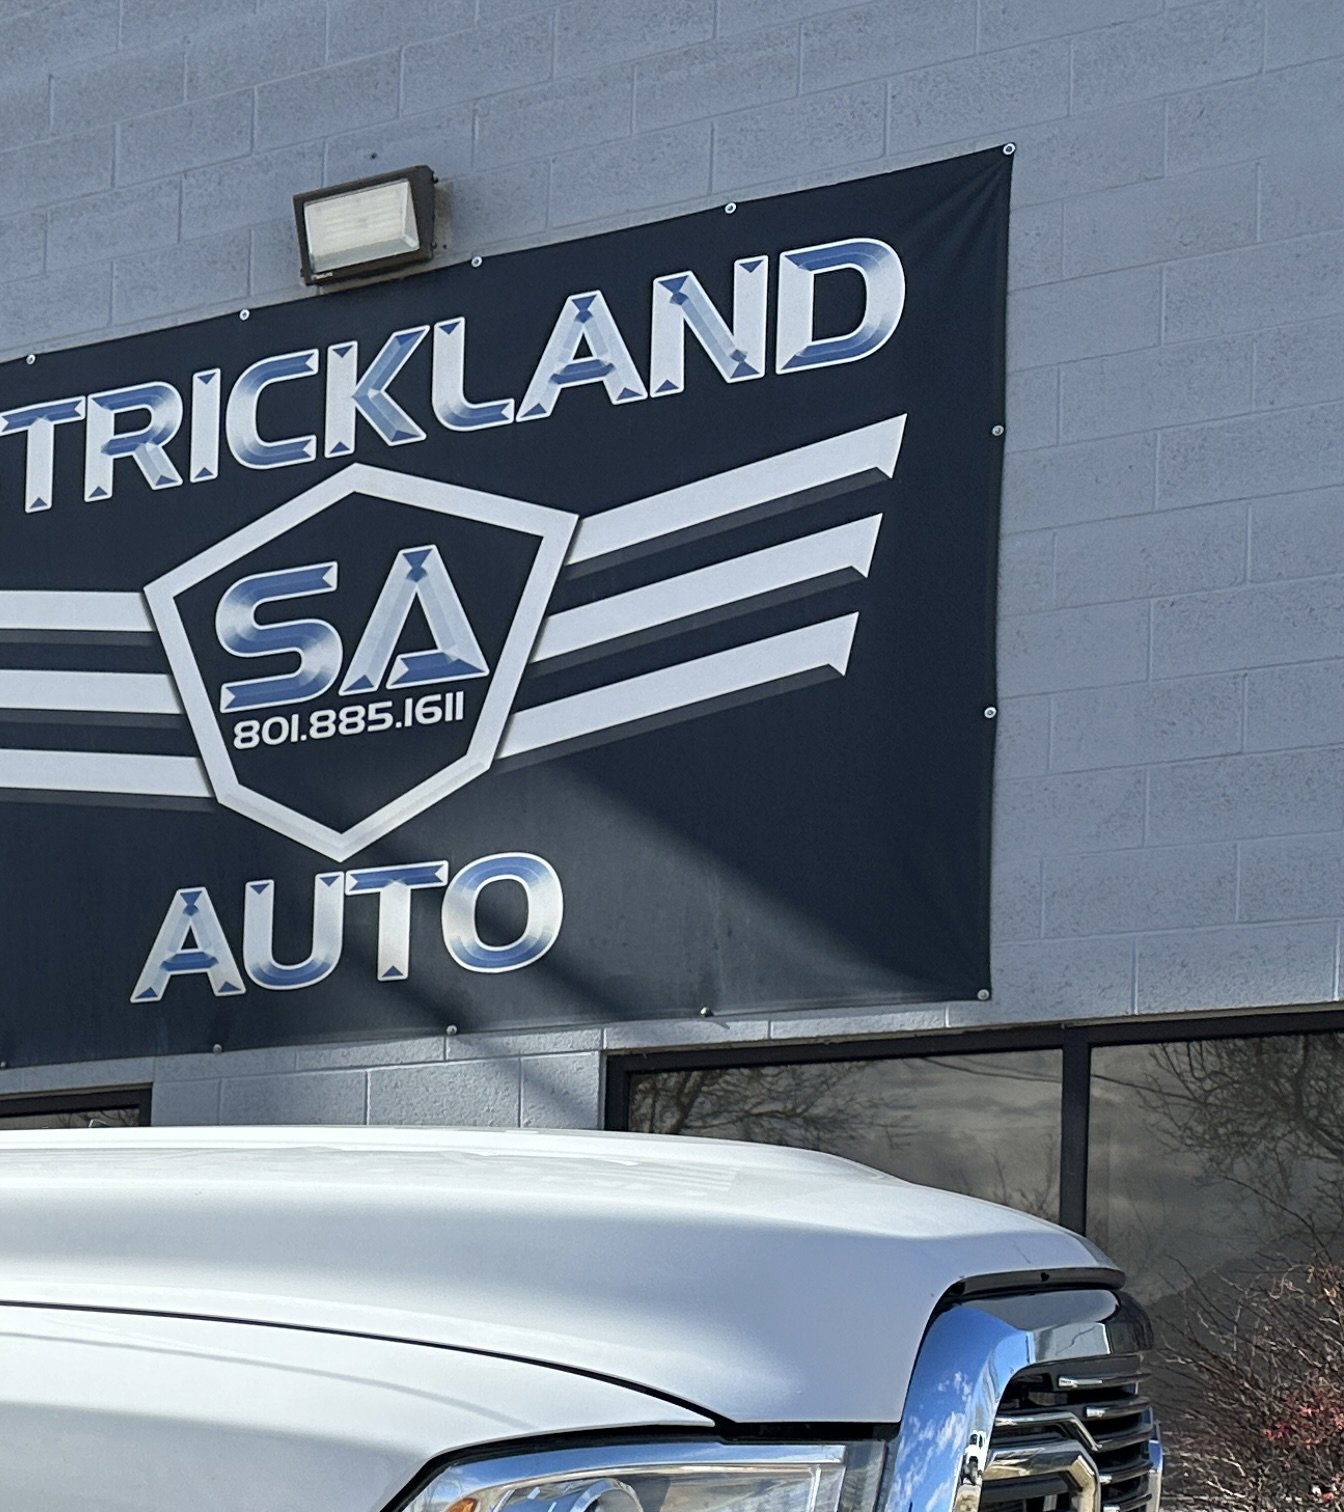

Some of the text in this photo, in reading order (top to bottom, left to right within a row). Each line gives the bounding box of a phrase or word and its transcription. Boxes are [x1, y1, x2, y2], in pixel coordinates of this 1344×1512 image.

[215, 544, 490, 713] SA
[233, 691, 464, 749] 801.885.1611
[130, 852, 564, 1003] AUTO
